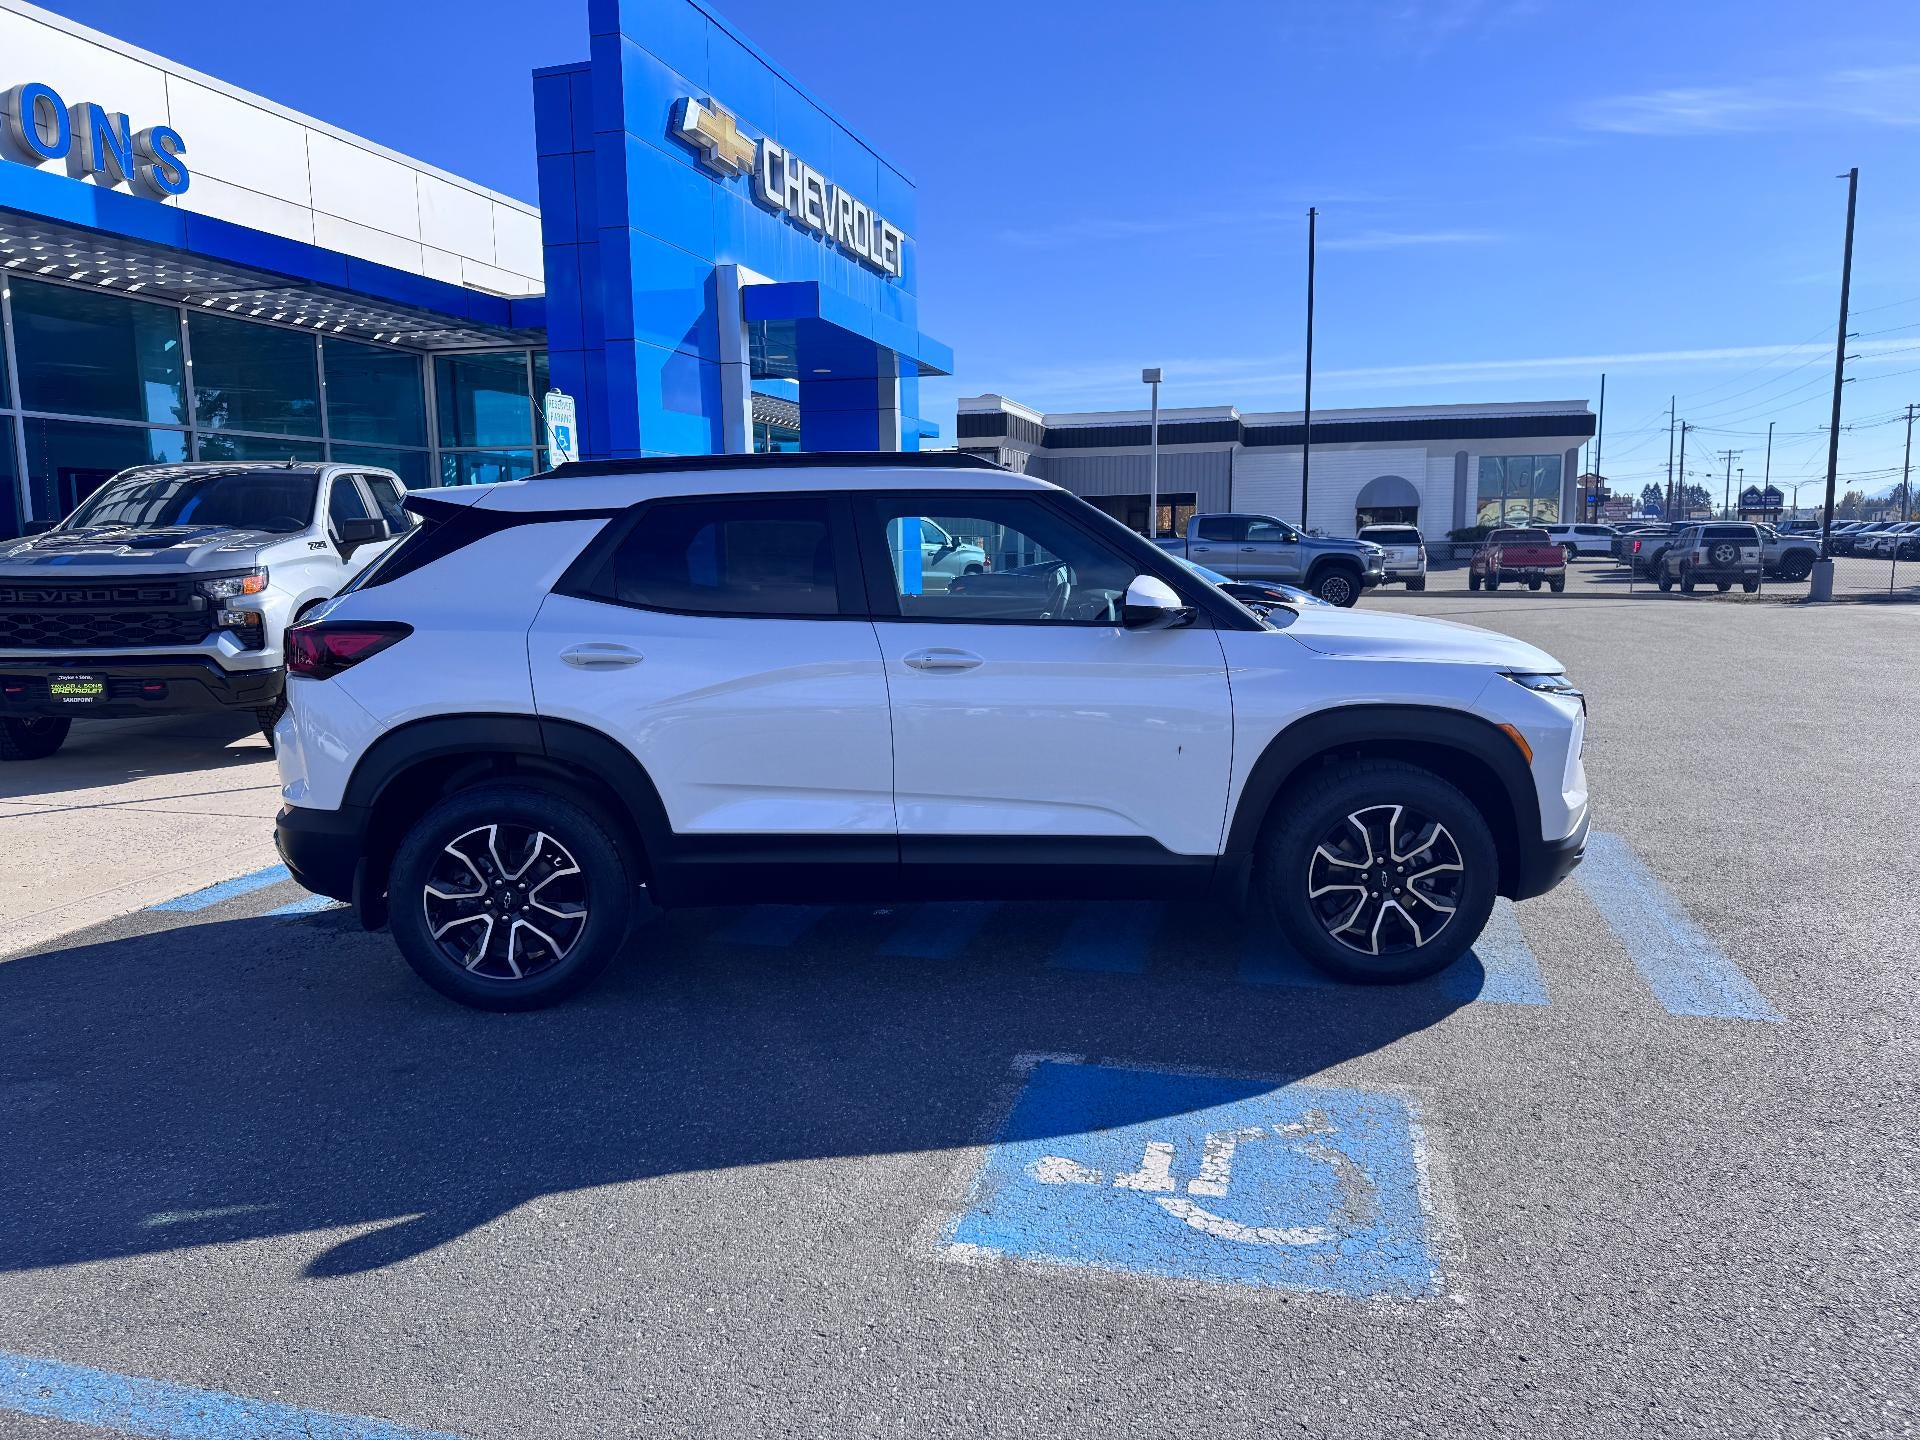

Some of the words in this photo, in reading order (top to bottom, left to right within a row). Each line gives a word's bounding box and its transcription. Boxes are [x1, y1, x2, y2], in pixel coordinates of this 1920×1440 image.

[0, 82, 190, 195] ONS
[762, 137, 905, 278] CHEVROLET
[0, 589, 176, 601] HEVROLET
